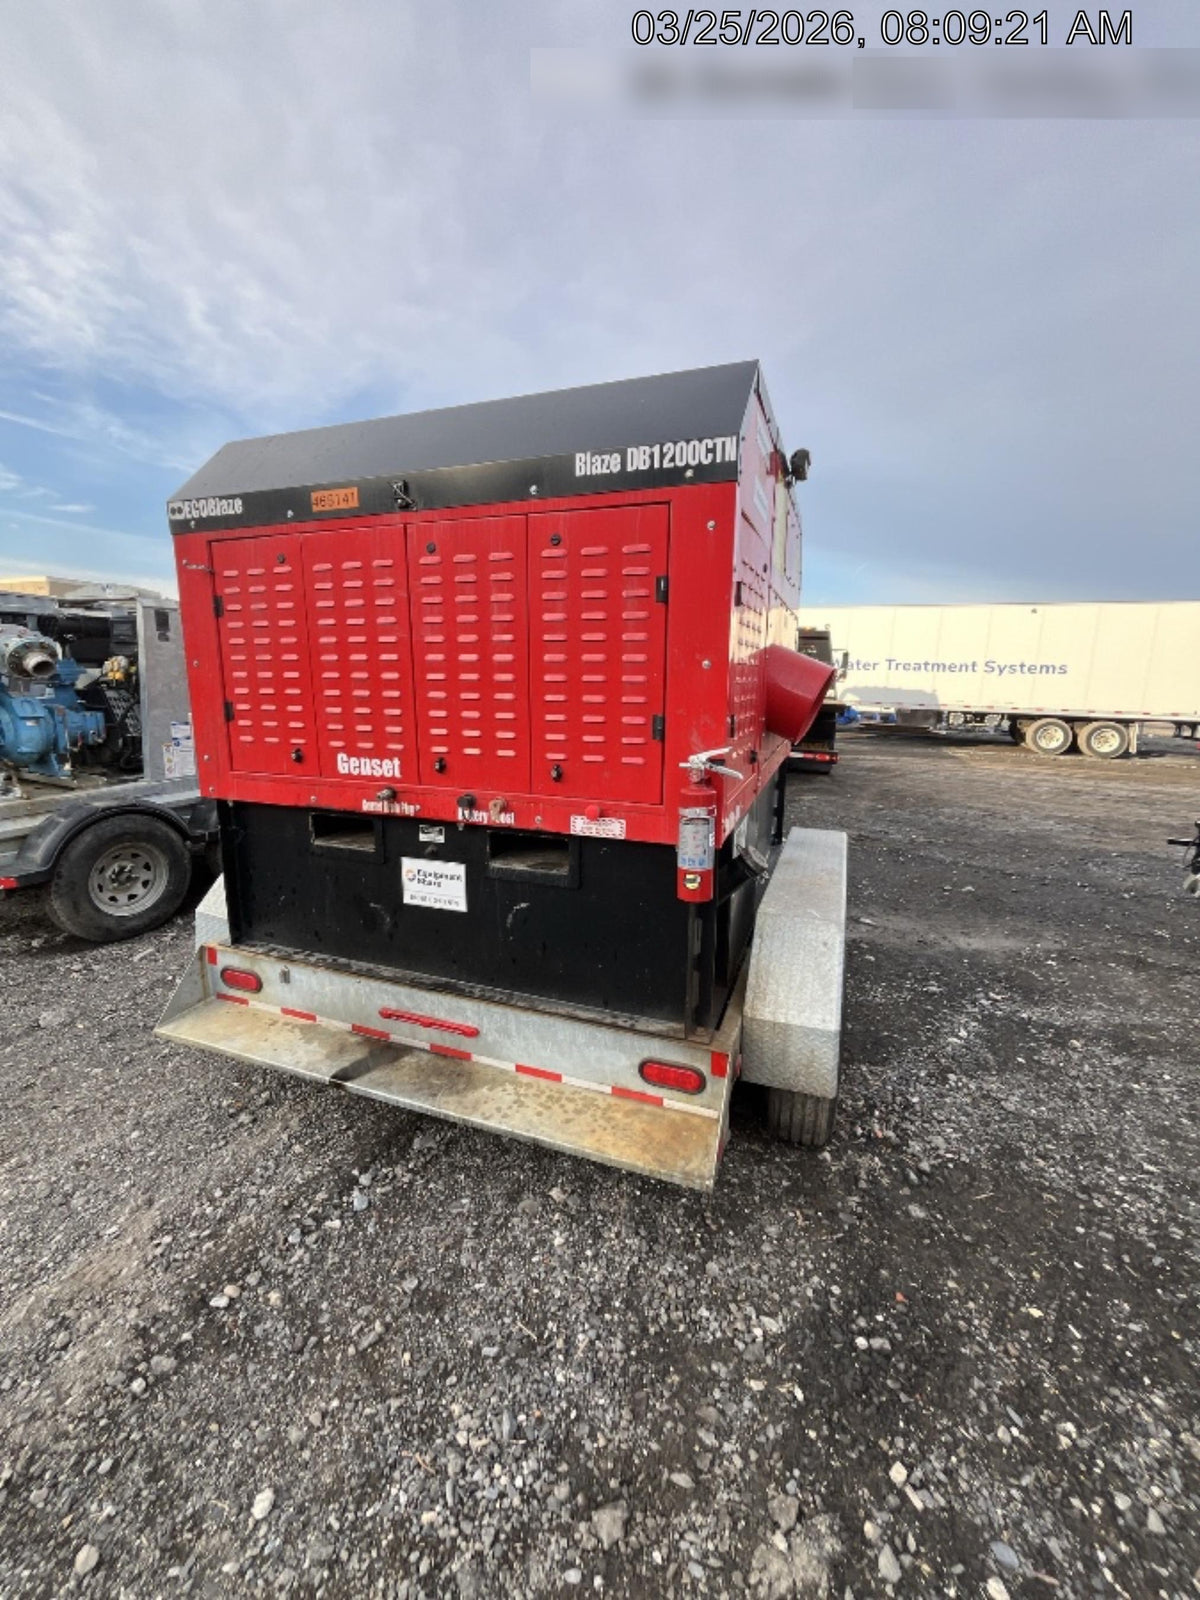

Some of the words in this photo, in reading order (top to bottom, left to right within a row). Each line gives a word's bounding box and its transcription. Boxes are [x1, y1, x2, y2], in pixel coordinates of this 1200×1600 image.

[575, 452, 621, 477] Blaze
[626, 435, 737, 472] DB1200CTN
[885, 659, 977, 673] Treatment
[983, 660, 1068, 676] Systems
[336, 752, 402, 778] Genset
